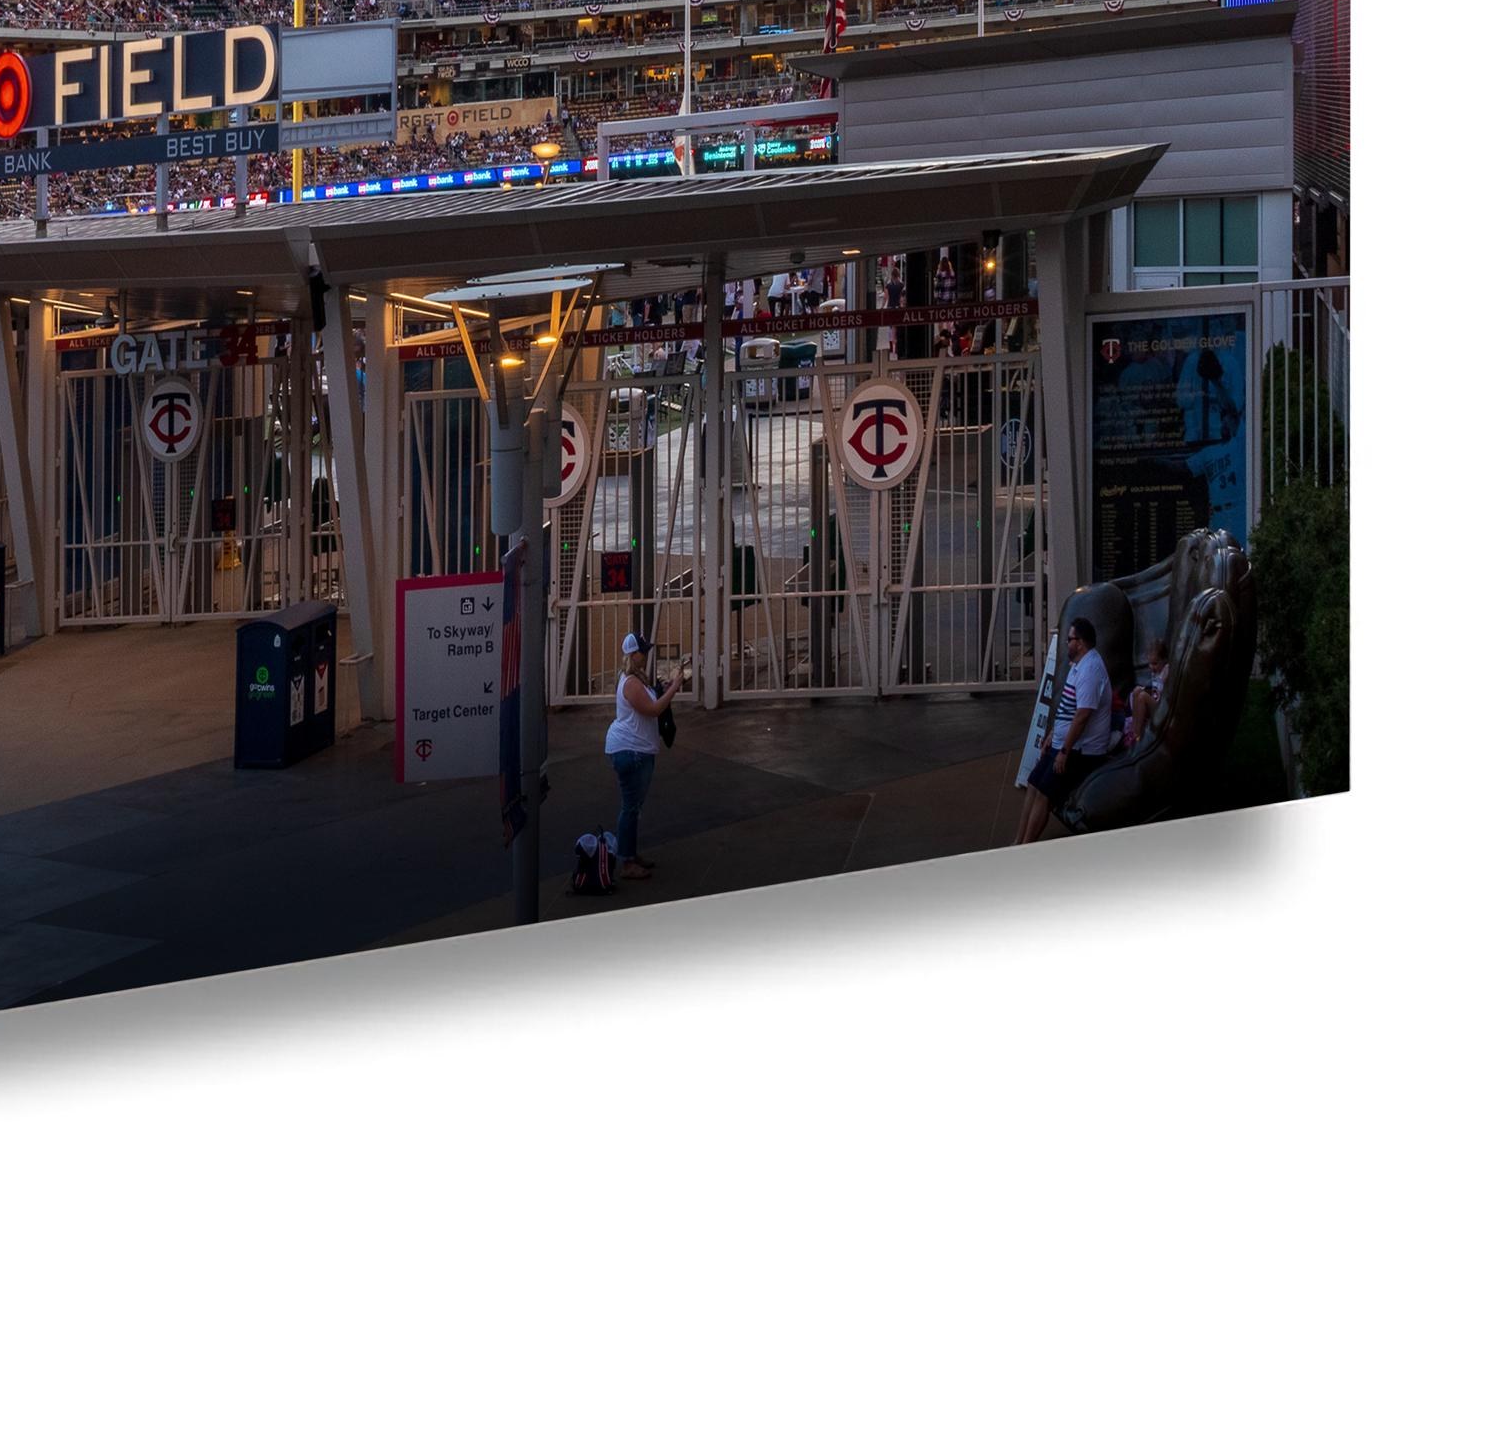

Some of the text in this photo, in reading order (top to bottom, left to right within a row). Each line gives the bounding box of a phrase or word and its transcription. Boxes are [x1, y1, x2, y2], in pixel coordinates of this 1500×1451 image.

[506, 57, 529, 68] WCCO
[55, 25, 277, 126] FIELD
[401, 106, 512, 129] RGET FIELD
[166, 129, 266, 158] BEST BUY
[4, 151, 52, 174] BANK
[902, 302, 1029, 323] ALL TICKET HOLDERS
[740, 314, 863, 334] ALL TICKET HOLDERS
[69, 338, 85, 349] ALL
[568, 327, 686, 347] AL TICKET HOLDERS
[1127, 335, 1237, 352] THE GOLDEN GLOVE
[110, 325, 258, 375] GATE 34
[416, 346, 436, 358] ALL
[607, 567, 627, 589] 34
[427, 623, 495, 641] To Skyway/
[448, 641, 494, 657] Ramp B
[412, 705, 494, 723] Target Center
